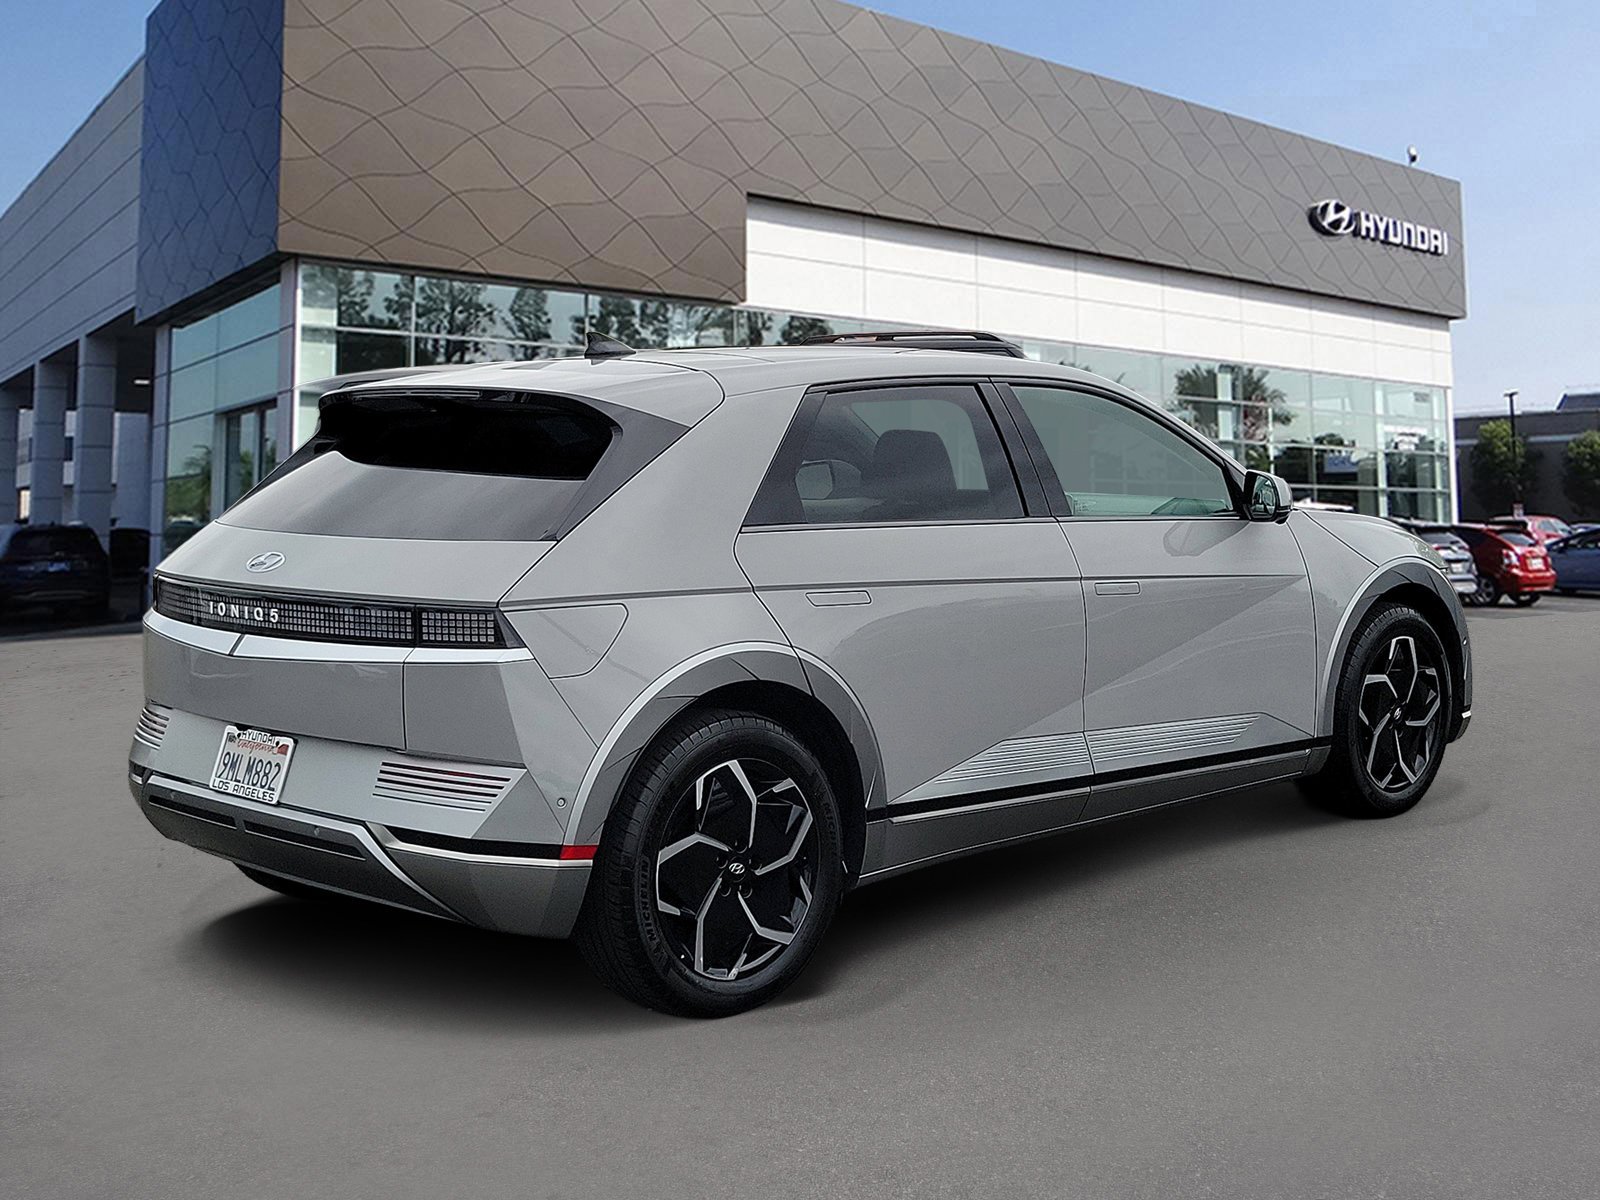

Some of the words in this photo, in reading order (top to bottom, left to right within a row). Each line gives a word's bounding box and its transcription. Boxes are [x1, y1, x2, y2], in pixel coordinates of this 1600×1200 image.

[1360, 211, 1448, 255] HYUNDAI
[209, 601, 264, 622] IONIQ
[270, 608, 279, 623] 5
[241, 730, 275, 745] HYUNDAI
[218, 751, 281, 791] 9MLM882
[212, 779, 230, 791] LOS
[233, 784, 275, 802] ANGELES
[639, 859, 657, 943] MICHELIN
